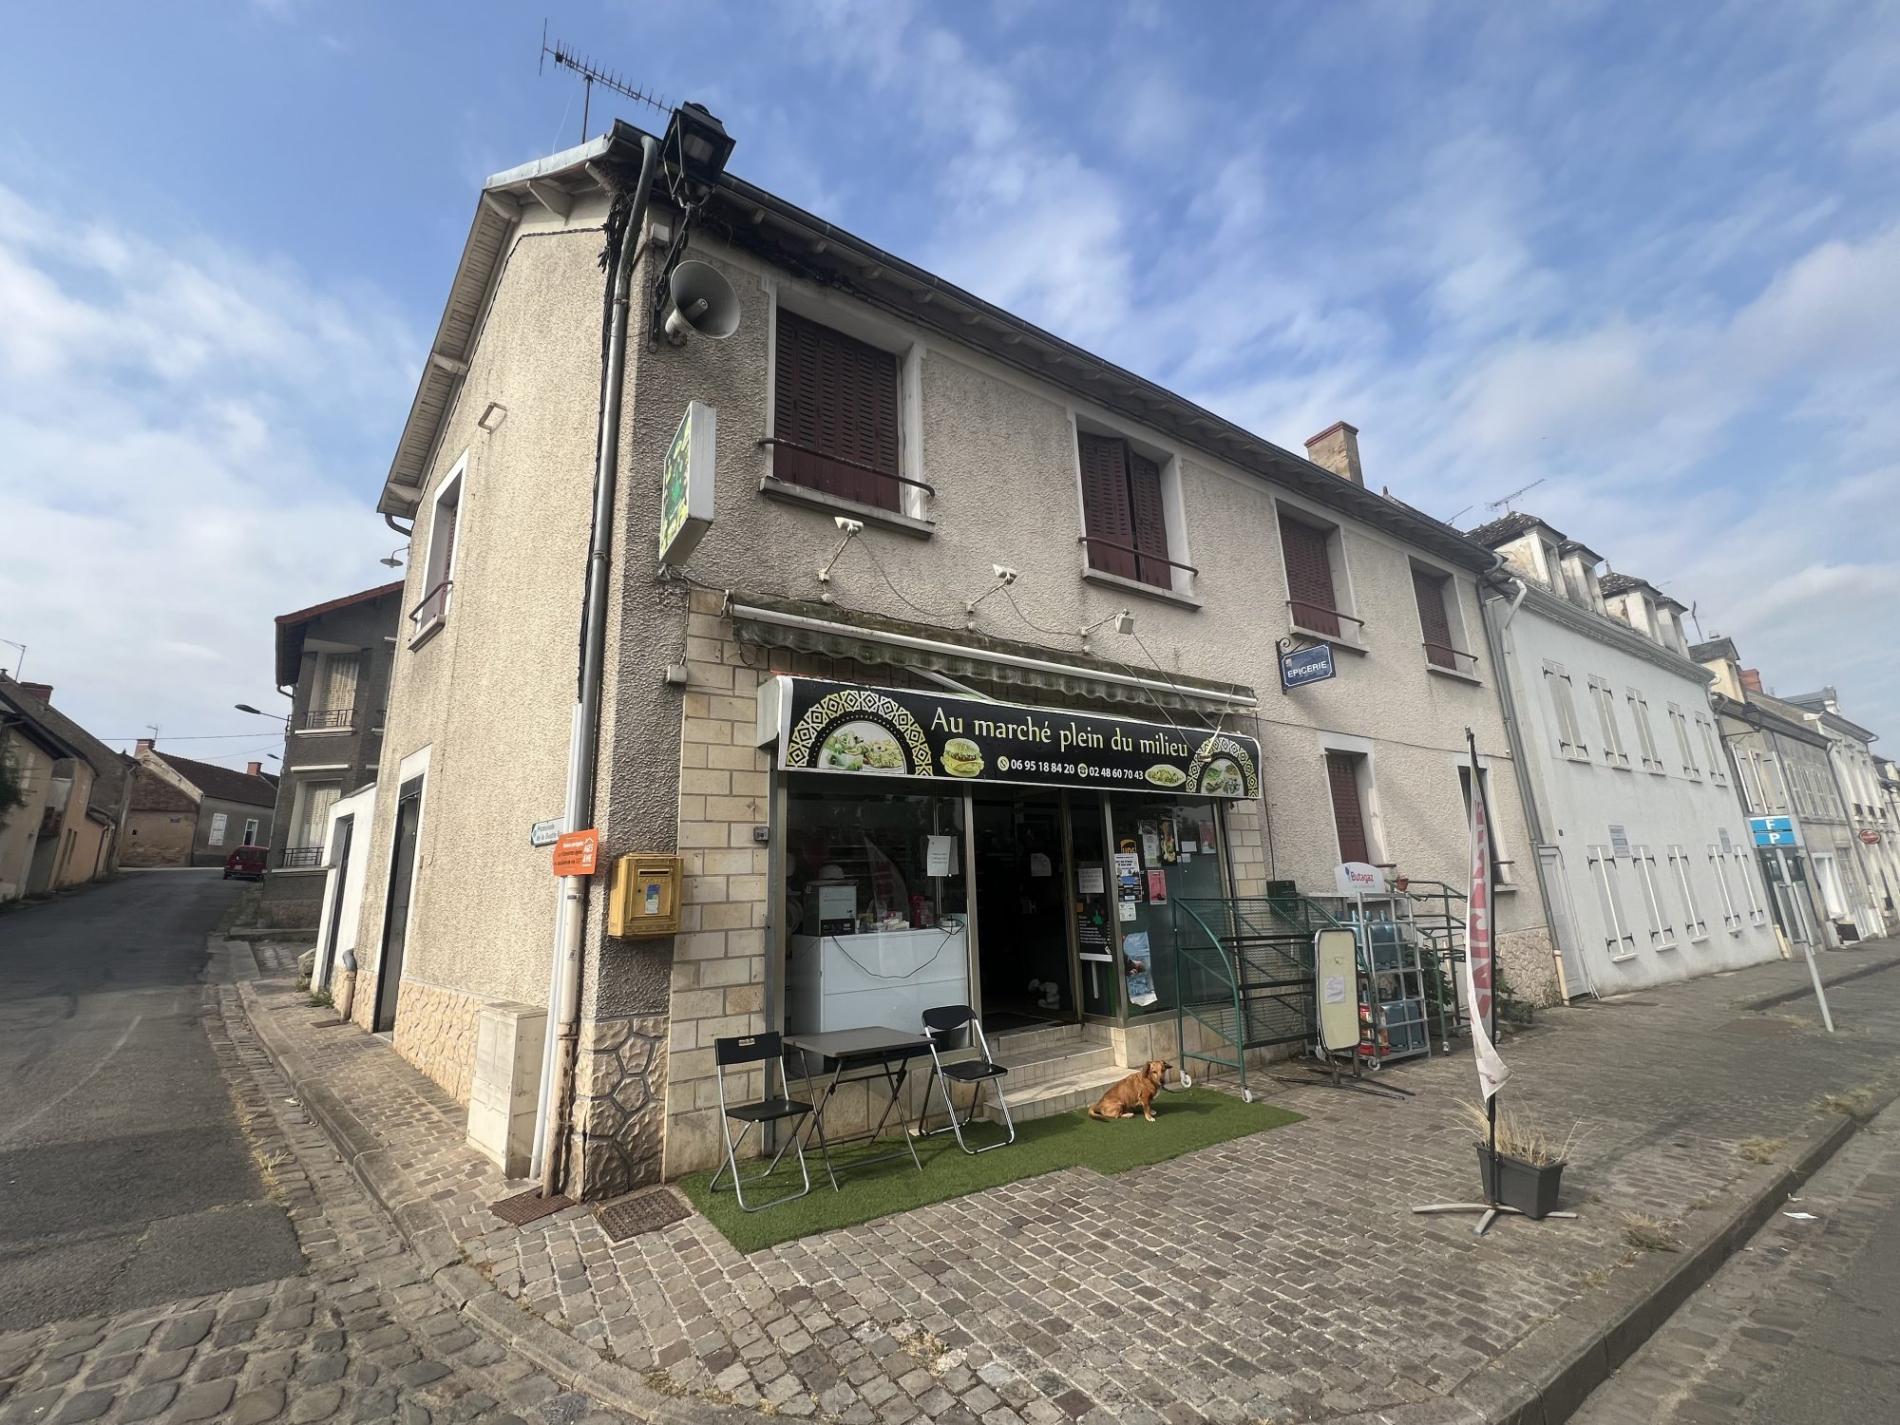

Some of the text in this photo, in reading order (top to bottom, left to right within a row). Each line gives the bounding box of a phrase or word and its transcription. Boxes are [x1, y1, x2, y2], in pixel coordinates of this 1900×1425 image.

[1287, 660, 1328, 678] EPICERIE
[931, 706, 1188, 757] Au marché plein du milieu
[1010, 758, 1075, 774] 06 95 18 84 20
[1089, 766, 1144, 780] 02 48 60 70 43
[1350, 871, 1374, 883] Butagaz
